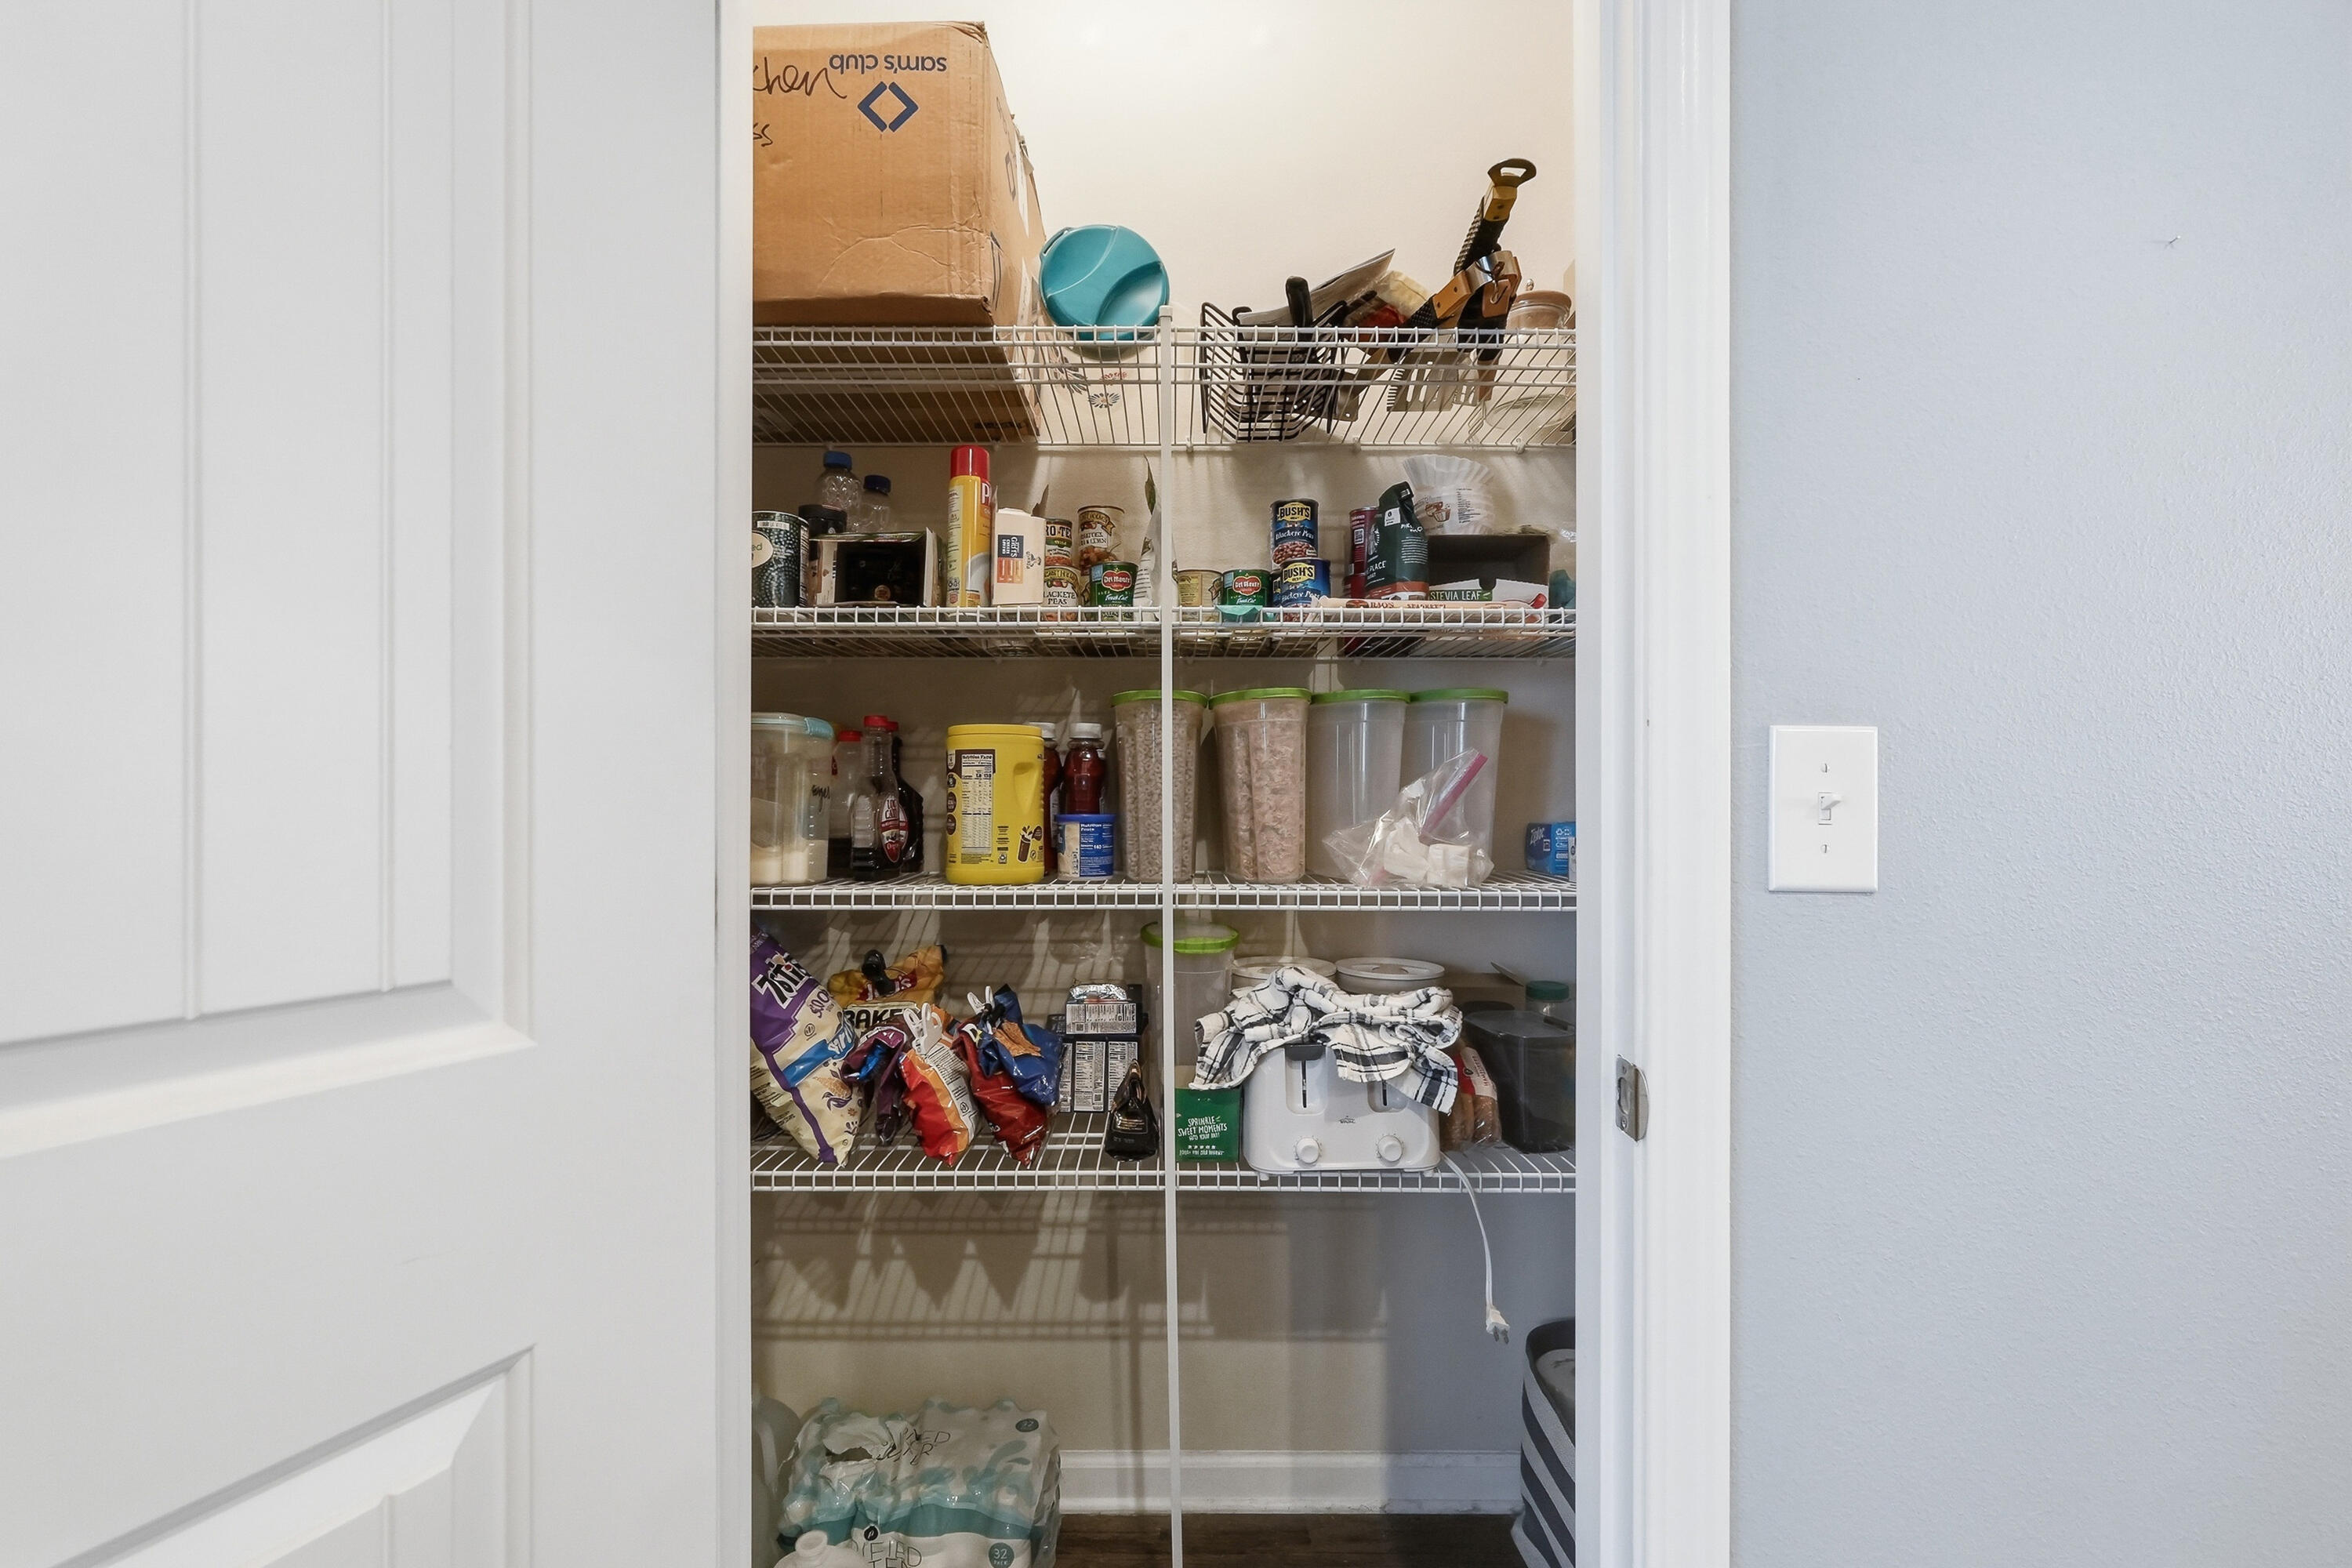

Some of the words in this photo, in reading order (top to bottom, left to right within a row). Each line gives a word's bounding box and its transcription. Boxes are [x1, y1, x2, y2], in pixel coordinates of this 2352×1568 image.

[829, 54, 879, 74] club
[884, 55, 948, 74] sam's
[1279, 506, 1310, 517] BUSH'S
[1283, 565, 1315, 581] BUSH'S
[1043, 590, 1076, 600] LACKEYE
[1430, 590, 1458, 601] STEVIA
[1461, 590, 1481, 601] LEAF
[1188, 1116, 1216, 1127] SPRINKLE
[1178, 1127, 1196, 1137] SWEET
[1198, 1123, 1228, 1134] MOMENTS
[993, 1548, 1008, 1559] 32
